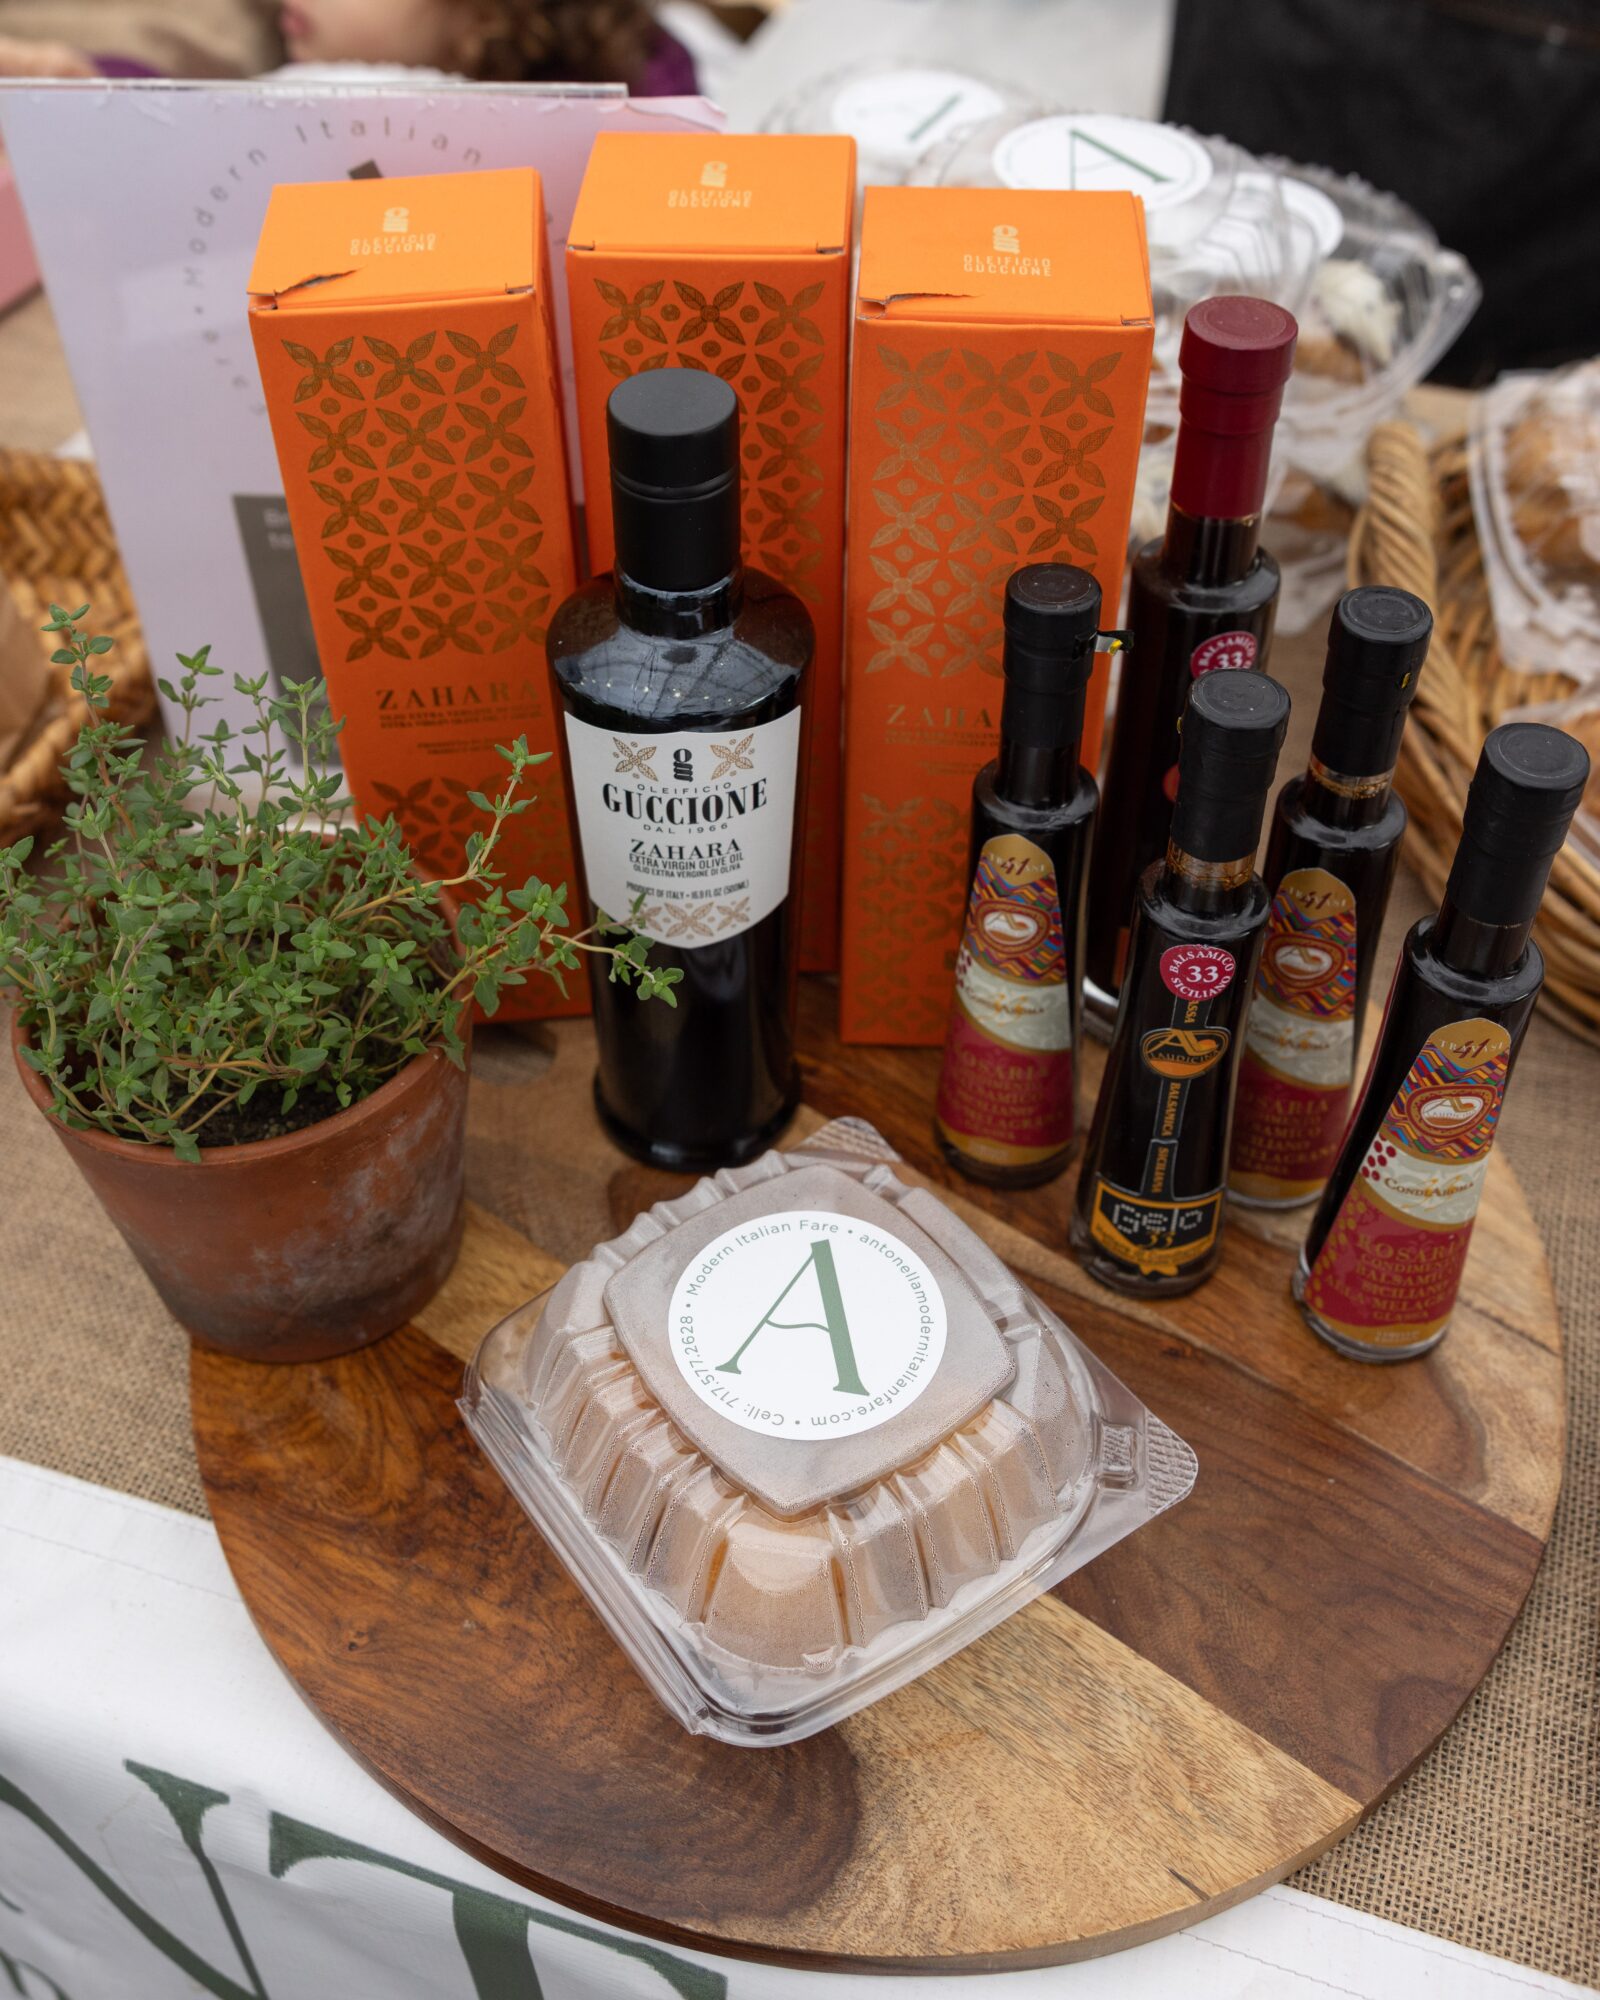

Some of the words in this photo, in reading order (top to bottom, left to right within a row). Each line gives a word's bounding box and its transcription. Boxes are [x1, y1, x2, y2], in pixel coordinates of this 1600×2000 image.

[294, 116, 483, 165] Italian
[964, 263, 1053, 277] GUCCIONE
[1216, 651, 1243, 668] 33
[375, 679, 540, 710] ZAHARA
[885, 703, 993, 728] ZAHA
[637, 781, 732, 795] OLEIFICIO
[602, 778, 768, 825] GUCCIONE
[643, 824, 676, 834] DAL
[688, 822, 728, 834] 1966
[629, 853, 660, 870] EXTRA
[661, 859, 696, 871] VIRGIN
[698, 856, 728, 871] OLIVE
[729, 852, 744, 866] OIL
[630, 838, 741, 860] ZAHARA
[633, 864, 650, 876] OLIO
[651, 868, 675, 878] EXTRA
[676, 868, 709, 878] VERGINE
[710, 867, 719, 877] DI
[720, 862, 741, 876] OLIVA
[665, 889, 685, 900] ITALY
[1168, 946, 1235, 974] BALSAMICO
[1186, 965, 1219, 983] 33
[1170, 975, 1232, 999] SICILIANO
[1160, 1081, 1182, 1137] BALSAMICA
[1112, 1203, 1203, 1234] Gelo
[687, 1244, 735, 1297] Modern
[735, 1222, 792, 1249] Italian
[799, 1219, 839, 1235] Fare
[714, 1238, 871, 1397] A
[810, 1232, 936, 1427] antonellamodernitalianfare.com
[679, 1314, 738, 1409] 717.577.2628
[742, 1402, 785, 1427] Cell:
